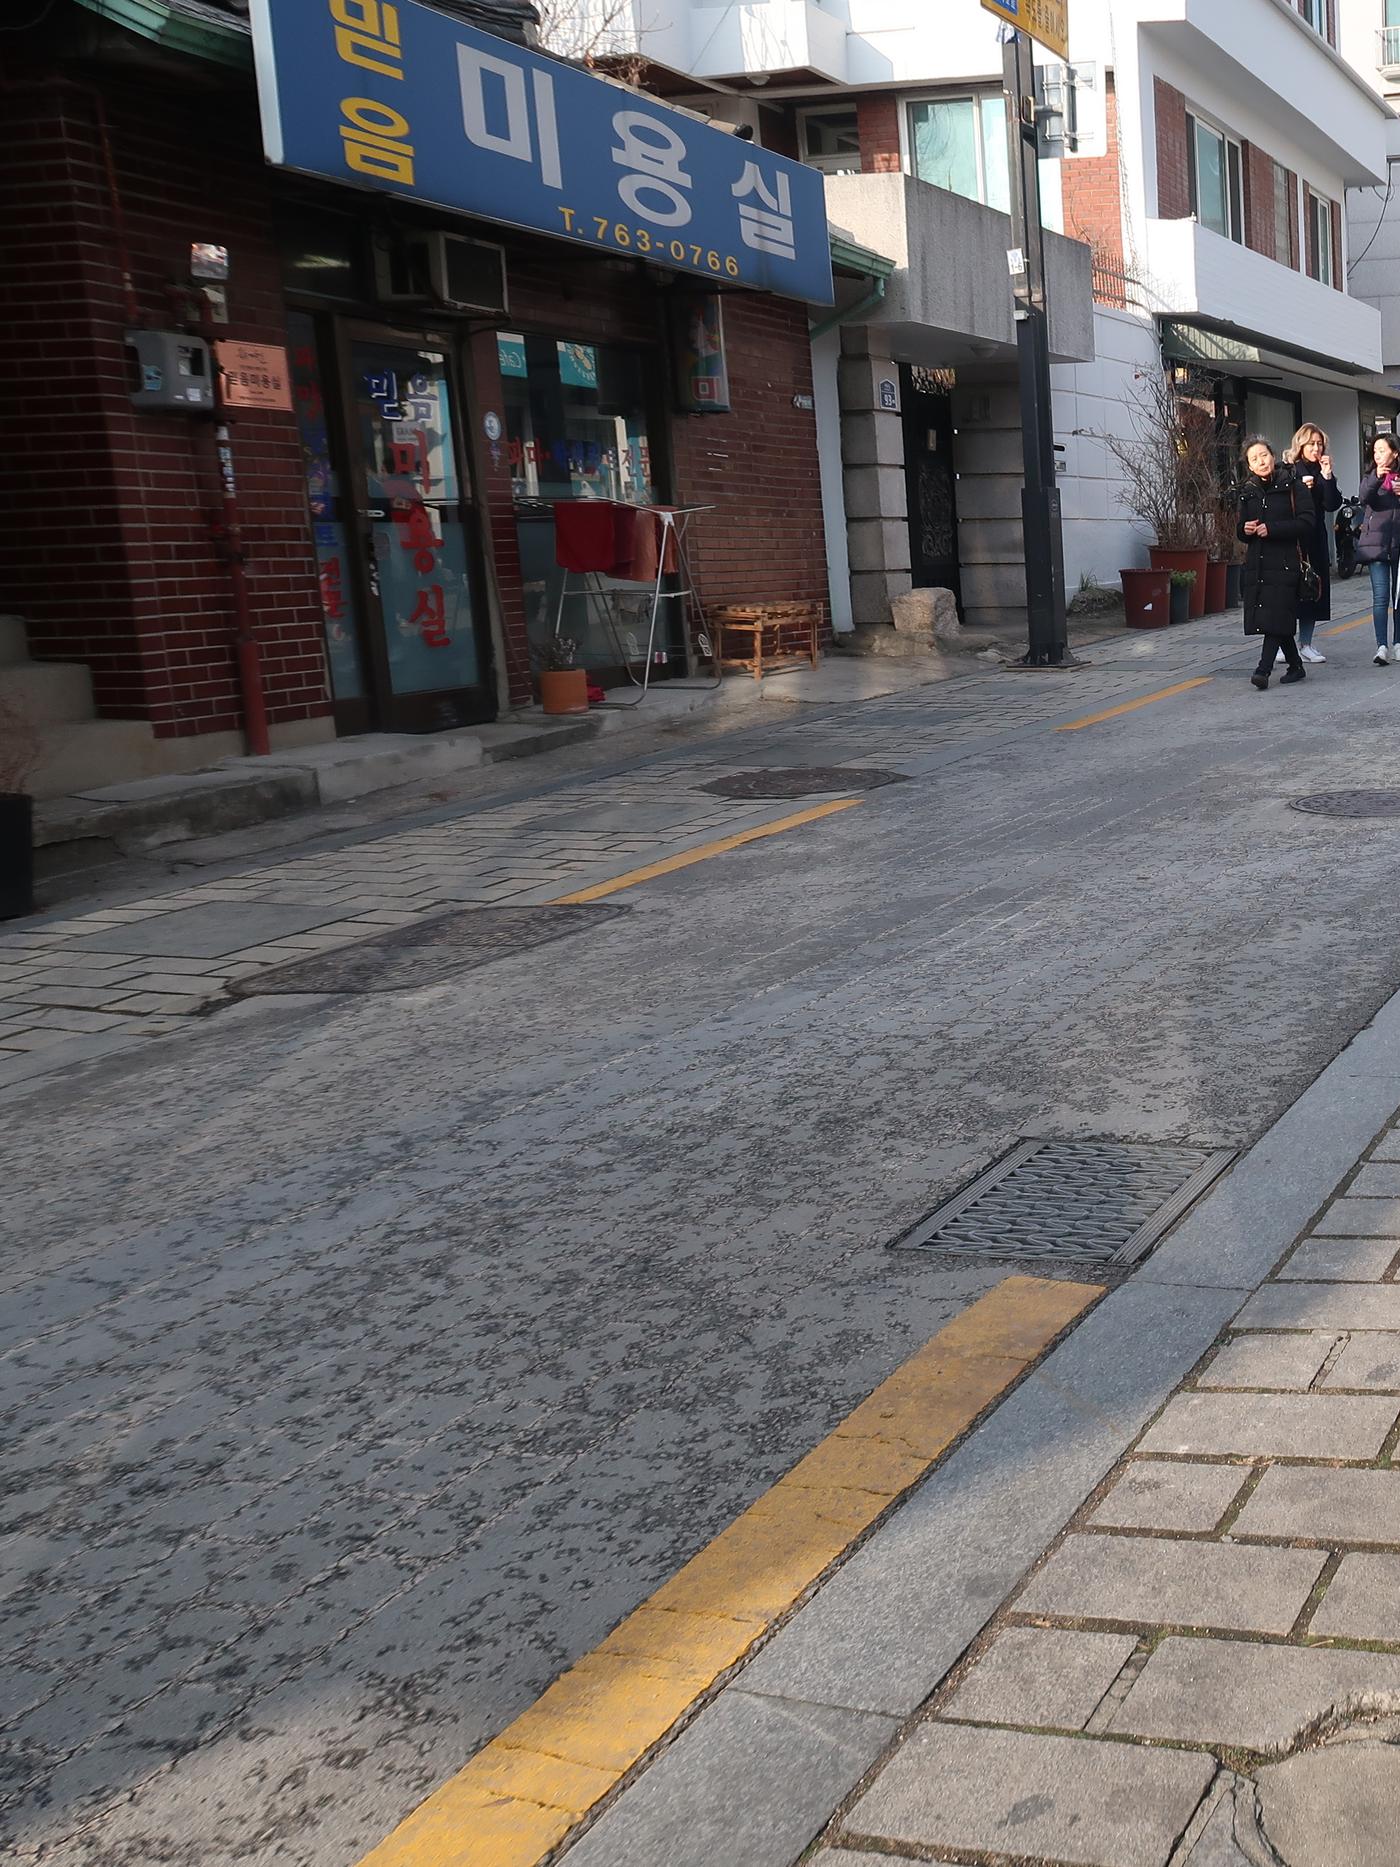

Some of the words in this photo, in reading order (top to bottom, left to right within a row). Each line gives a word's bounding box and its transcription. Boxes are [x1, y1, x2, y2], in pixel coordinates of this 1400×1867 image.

[329, 0, 415, 186] 믿음
[455, 41, 796, 261] 미용실
[364, 370, 438, 423] 믿음
